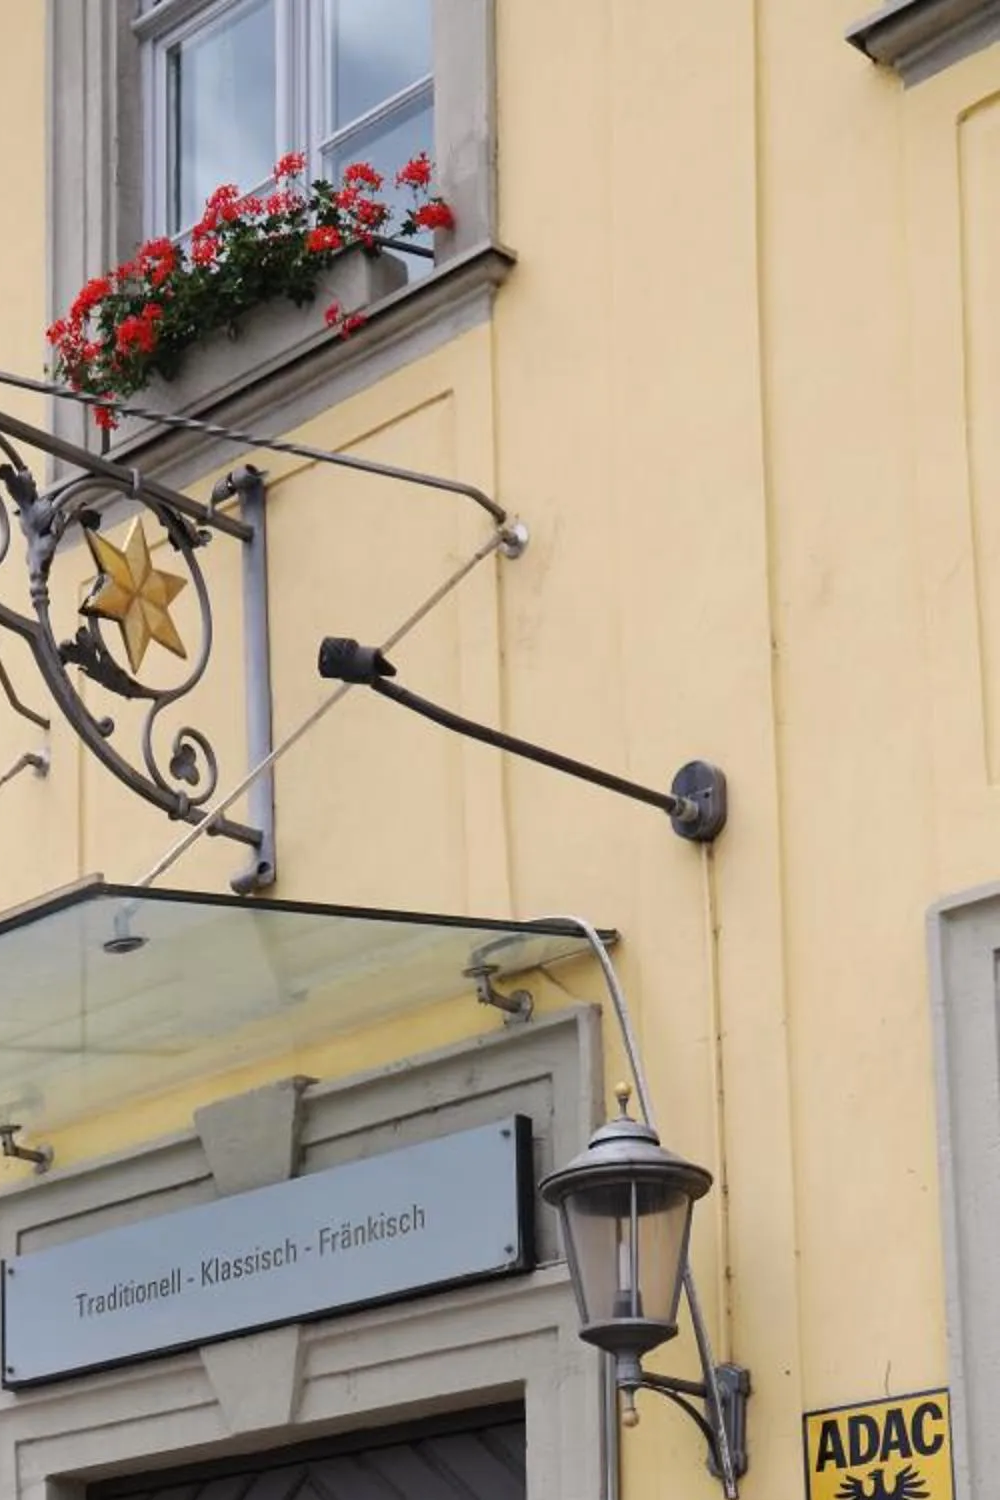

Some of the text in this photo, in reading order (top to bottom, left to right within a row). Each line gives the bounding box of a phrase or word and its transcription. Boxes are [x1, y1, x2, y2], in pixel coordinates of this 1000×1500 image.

[76, 1268, 181, 1318] Traditionell
[201, 1238, 297, 1287] Klassisch
[319, 1204, 426, 1258] Fränkisch
[815, 1401, 945, 1473] ADAC
